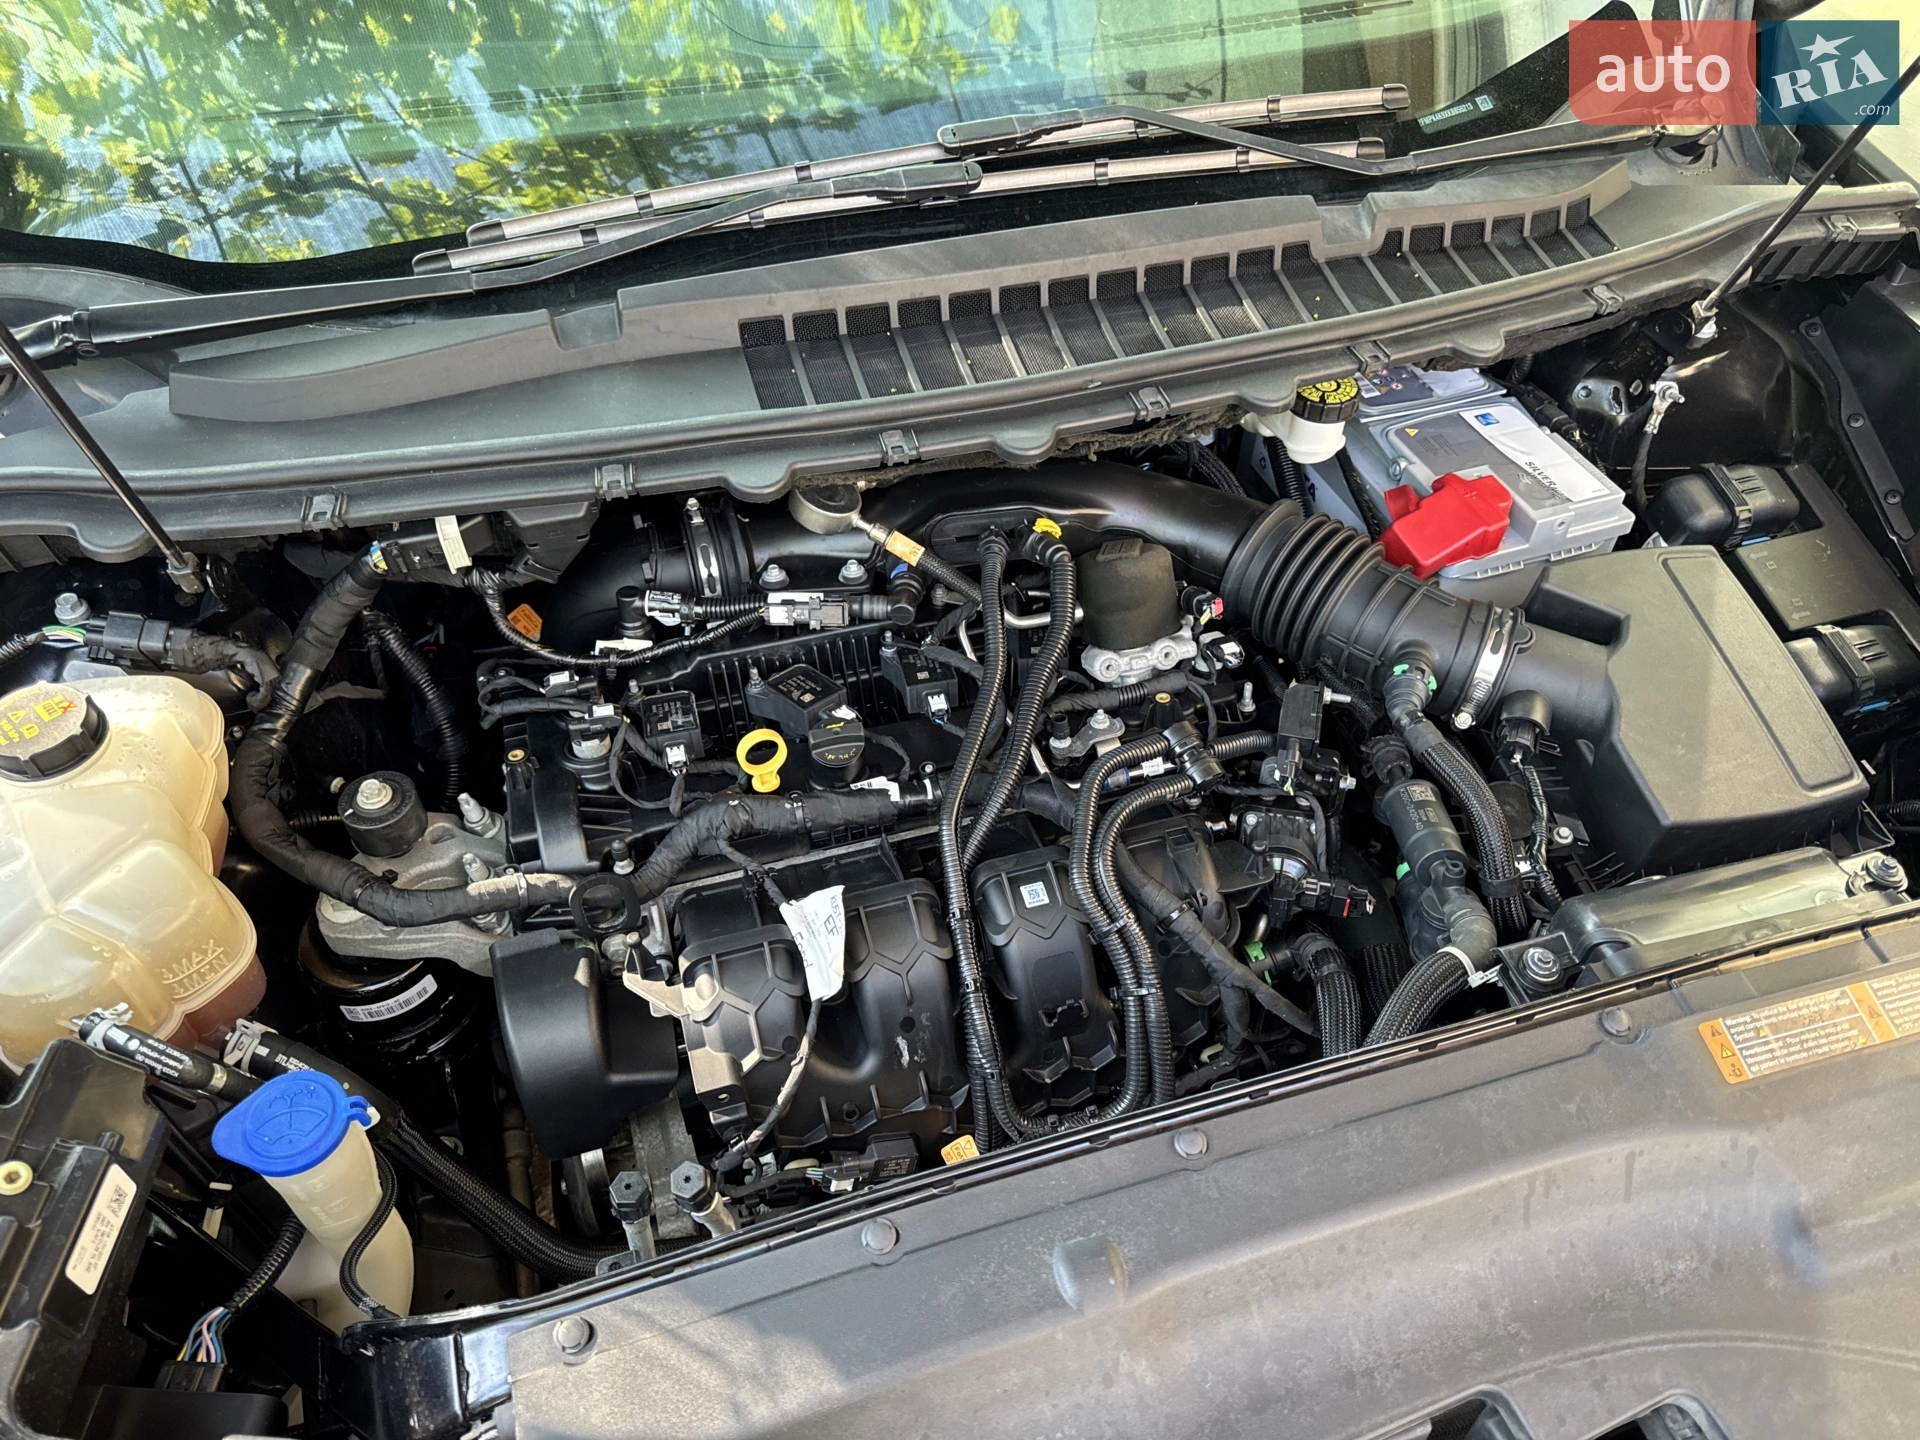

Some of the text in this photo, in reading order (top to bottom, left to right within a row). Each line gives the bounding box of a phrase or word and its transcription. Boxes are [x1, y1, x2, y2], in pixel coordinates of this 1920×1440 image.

[1524, 461, 1557, 488] SILVER
[172, 939, 222, 976] MAX
[182, 953, 230, 991] MIN
[1724, 1015, 1752, 1026] Warning:
